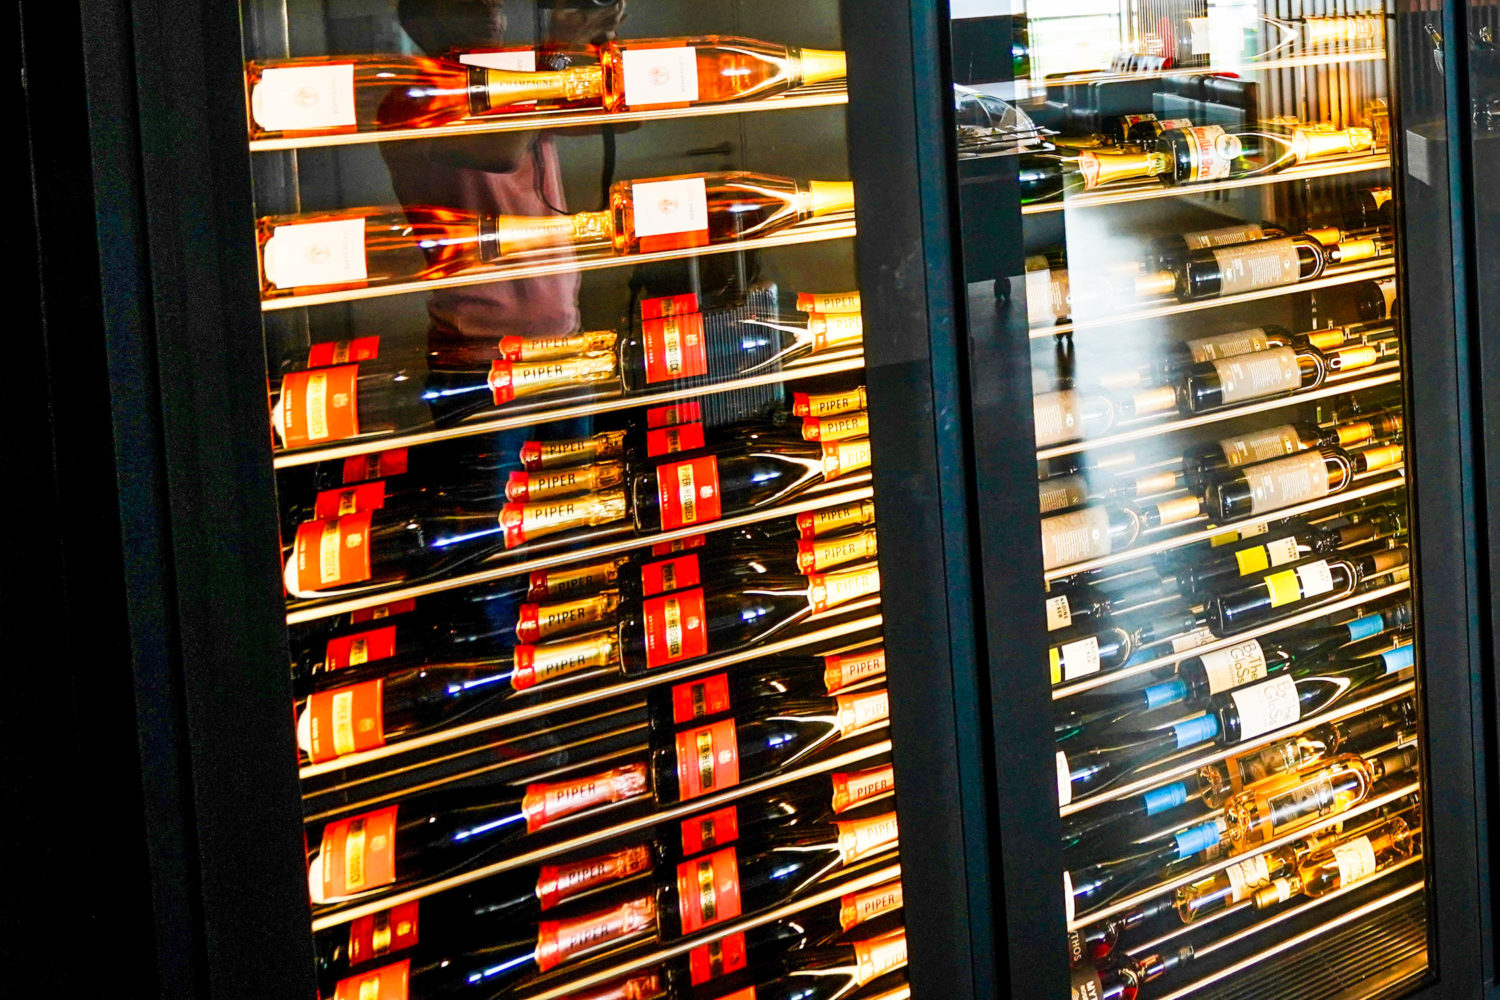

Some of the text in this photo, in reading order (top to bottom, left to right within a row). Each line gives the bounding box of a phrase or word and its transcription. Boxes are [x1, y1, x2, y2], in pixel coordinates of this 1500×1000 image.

[823, 296, 855, 308] PIPER
[531, 337, 569, 350] PIPER
[523, 364, 563, 379] PIPER
[820, 398, 849, 412] PIPER
[828, 418, 858, 433] PIPER
[550, 441, 585, 456] PIPER
[538, 473, 576, 491] PIPER
[535, 503, 575, 520] PIPER
[821, 508, 851, 522] PIPER
[824, 543, 856, 560] PIPER
[559, 575, 593, 593] PIPER
[836, 576, 870, 593] PIPER
[548, 607, 585, 627] PIPER
[1060, 598, 1068, 619] NADINE
[546, 654, 586, 675] PIPER
[850, 659, 880, 676] PIPER
[557, 783, 596, 802] PIPER
[857, 780, 888, 798] PIPER
[569, 863, 606, 885] PIPER
[865, 895, 895, 913] PIPER
[569, 925, 609, 948] PIPER
